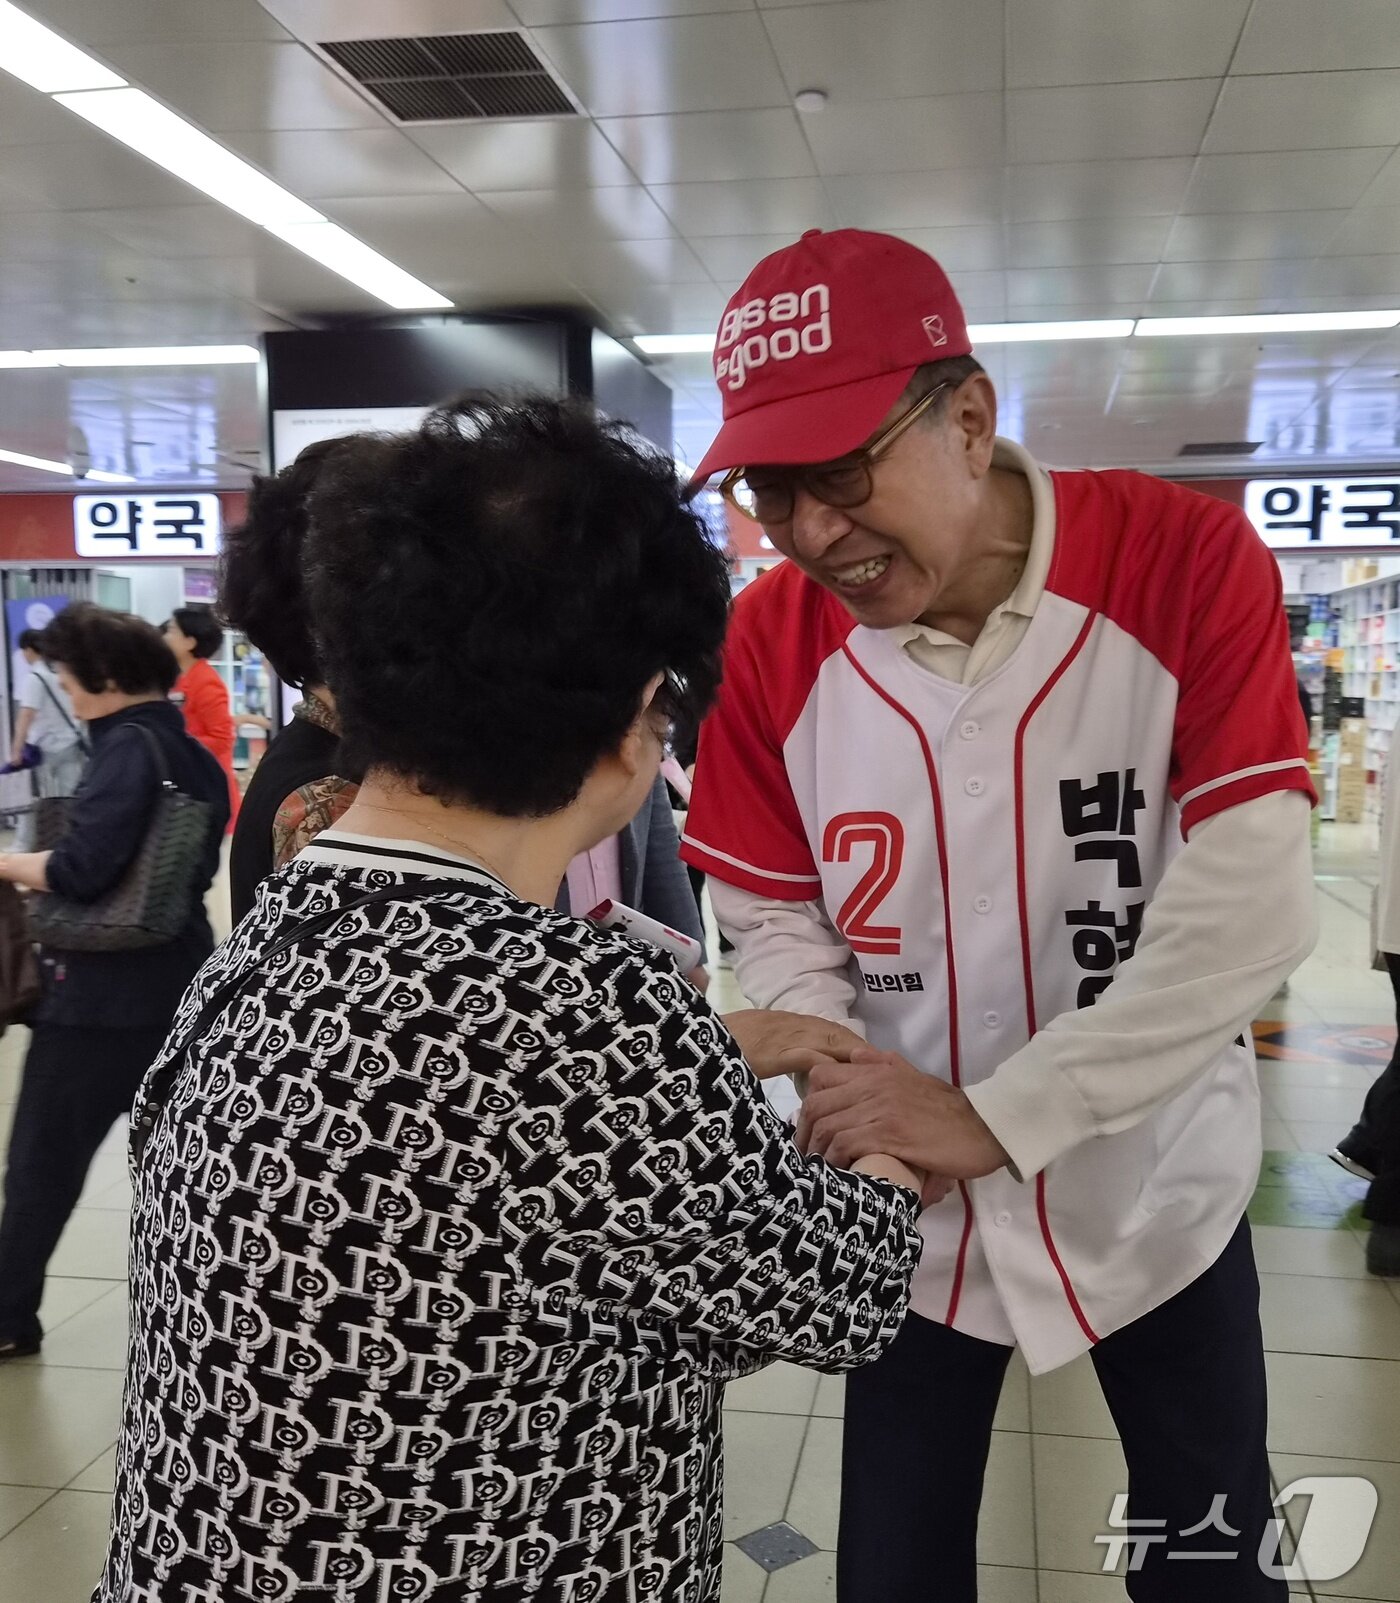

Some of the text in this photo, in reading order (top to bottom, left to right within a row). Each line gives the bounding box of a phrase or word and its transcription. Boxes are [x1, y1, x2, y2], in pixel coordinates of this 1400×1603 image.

[727, 312, 832, 391] good
[90, 500, 205, 550] 약국
[1264, 484, 1400, 541] 약국
[822, 811, 905, 955] 2
[862, 971, 925, 993] 민의힘
